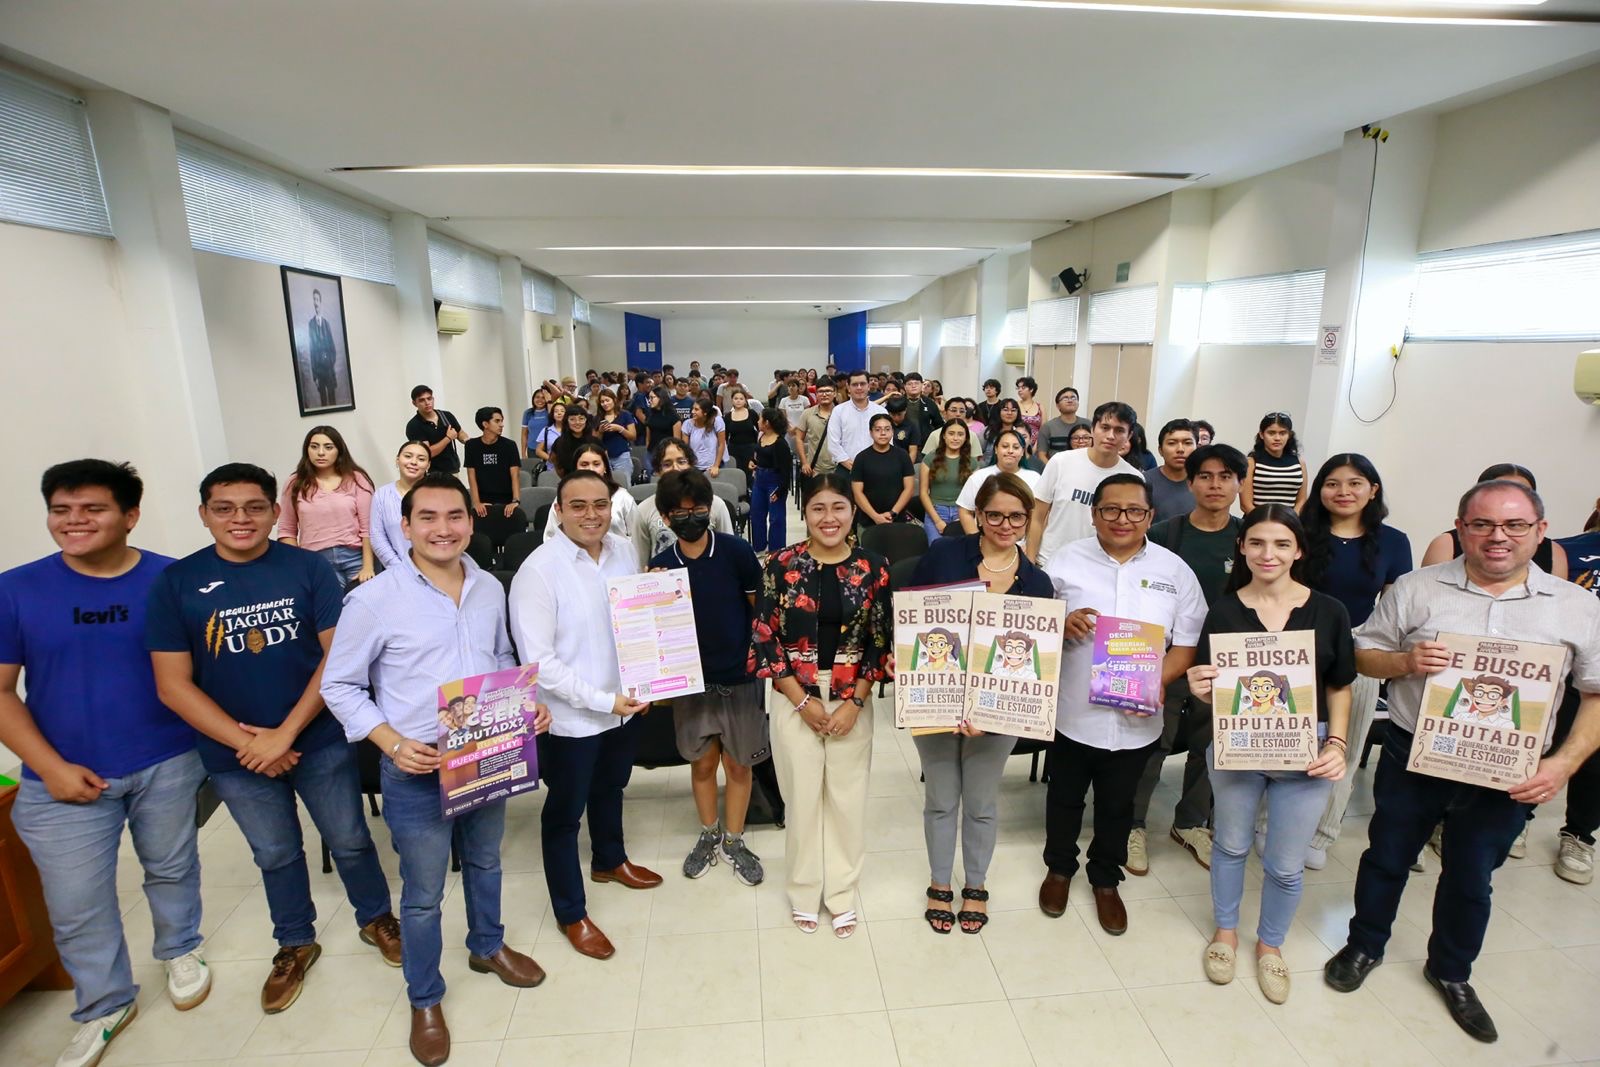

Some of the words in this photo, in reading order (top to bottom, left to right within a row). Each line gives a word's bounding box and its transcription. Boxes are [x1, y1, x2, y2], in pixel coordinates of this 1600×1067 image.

[219, 597, 295, 618] ORGULLOSAMENTE
[898, 609, 918, 625] SE
[925, 608, 971, 625] BUSC
[225, 607, 297, 634] JAGUAR
[975, 610, 997, 627] SE
[1002, 612, 1059, 634] BUSCA
[1216, 652, 1239, 668] SE
[1246, 649, 1310, 667] BUSCA
[1448, 652, 1466, 669] E
[1473, 655, 1553, 682] BUSCA
[970, 675, 1054, 698] DIPUTADO
[926, 694, 936, 704] EL
[996, 700, 1006, 711] EL
[1007, 701, 1042, 715] ESTADO?
[447, 717, 524, 749] DIPUTADX?
[1219, 717, 1312, 730] DIPUTADA
[1423, 718, 1537, 749] DIPUTADO
[1250, 739, 1260, 748] EL
[1262, 738, 1301, 748] ESTADO?
[451, 752, 480, 767] PUEDE
[1456, 746, 1468, 758] EL
[1470, 749, 1518, 767] ESTADO?
